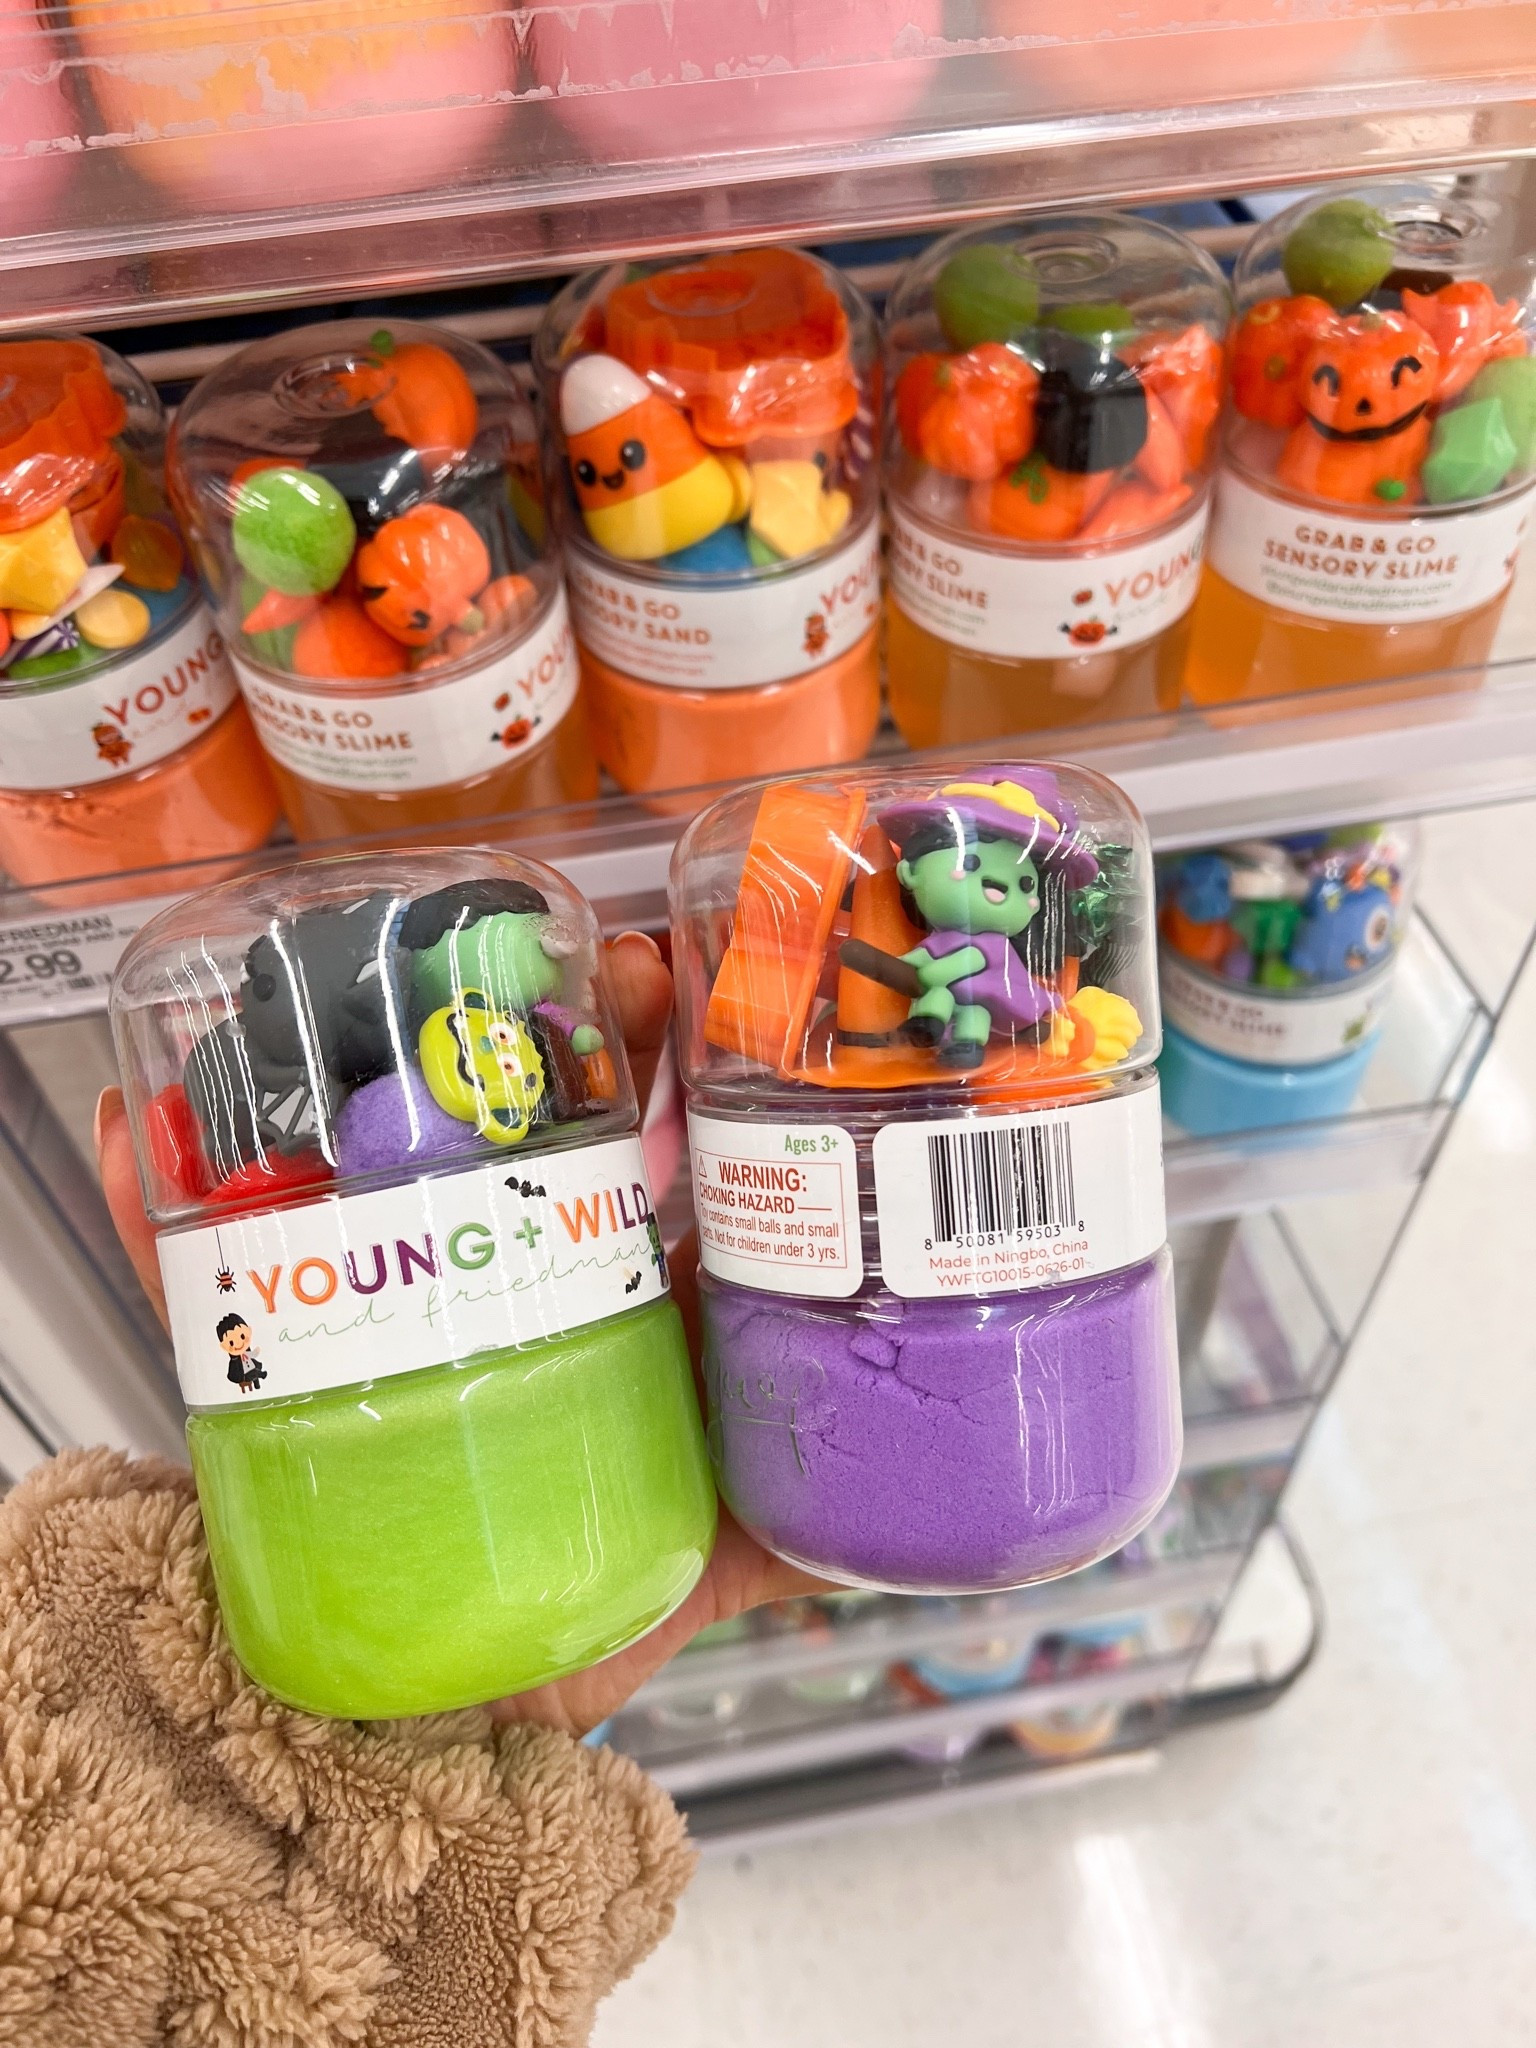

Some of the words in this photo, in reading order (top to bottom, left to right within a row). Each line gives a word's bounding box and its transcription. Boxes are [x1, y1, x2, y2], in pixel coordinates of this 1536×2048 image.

[1296, 524, 1365, 553] GRAB
[1370, 537, 1388, 555] &
[1397, 536, 1436, 555] GO
[931, 552, 962, 577] GO
[1265, 539, 1377, 580] SENSORY
[1384, 555, 1459, 580] SLIME
[927, 572, 988, 610] SLIME
[643, 600, 681, 621] GO
[645, 622, 712, 645] SAND
[333, 710, 373, 728] GO
[335, 731, 413, 751] SLIME
[784, 1134, 817, 1156] Ages
[821, 1135, 839, 1152] 3+
[718, 1160, 807, 1192] WARNING:
[699, 1181, 736, 1207] CHOKING
[738, 1191, 795, 1214] HAZARD
[708, 1209, 734, 1227] contains
[734, 1216, 757, 1231] small
[758, 1217, 782, 1234] balls
[784, 1221, 805, 1236] and
[808, 1223, 839, 1238] small
[924, 1239, 933, 1250] 8
[956, 1233, 1005, 1249] 50081
[1016, 1225, 1062, 1242] 59503
[1078, 1220, 1085, 1232] 8
[246, 1222, 496, 1314] YOUNG
[554, 1182, 648, 1243] WILD
[714, 1229, 726, 1245] Not
[726, 1231, 736, 1246] for
[737, 1234, 771, 1254] children
[774, 1242, 804, 1257] under
[808, 1243, 815, 1258] 3
[817, 1248, 841, 1263] yrs.
[929, 1256, 972, 1269] Made
[977, 1253, 990, 1266] in
[995, 1248, 1050, 1264] Ningbo,
[1053, 1240, 1089, 1256] China
[278, 1298, 395, 1342] and
[422, 1243, 651, 1328] friedman
